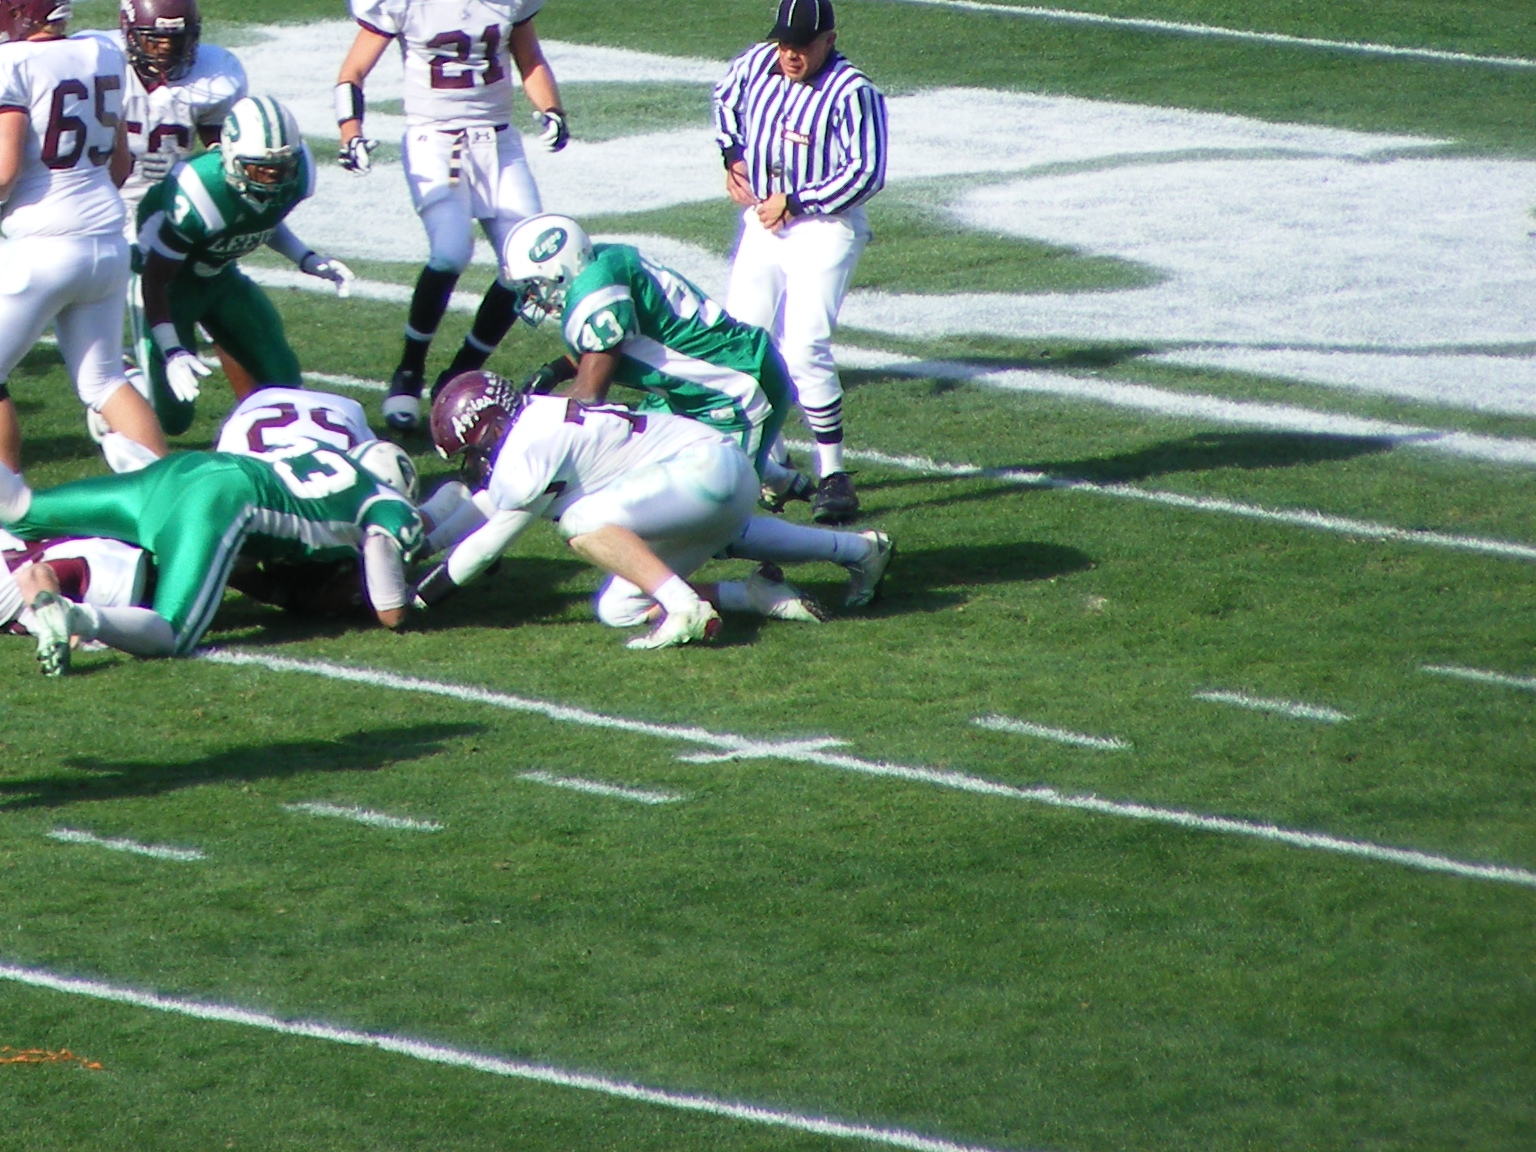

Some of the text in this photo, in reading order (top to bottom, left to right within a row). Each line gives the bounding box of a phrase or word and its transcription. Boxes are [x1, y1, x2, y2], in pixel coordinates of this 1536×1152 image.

[426, 23, 505, 89] 21
[41, 74, 120, 170] 65
[579, 309, 625, 352] 43
